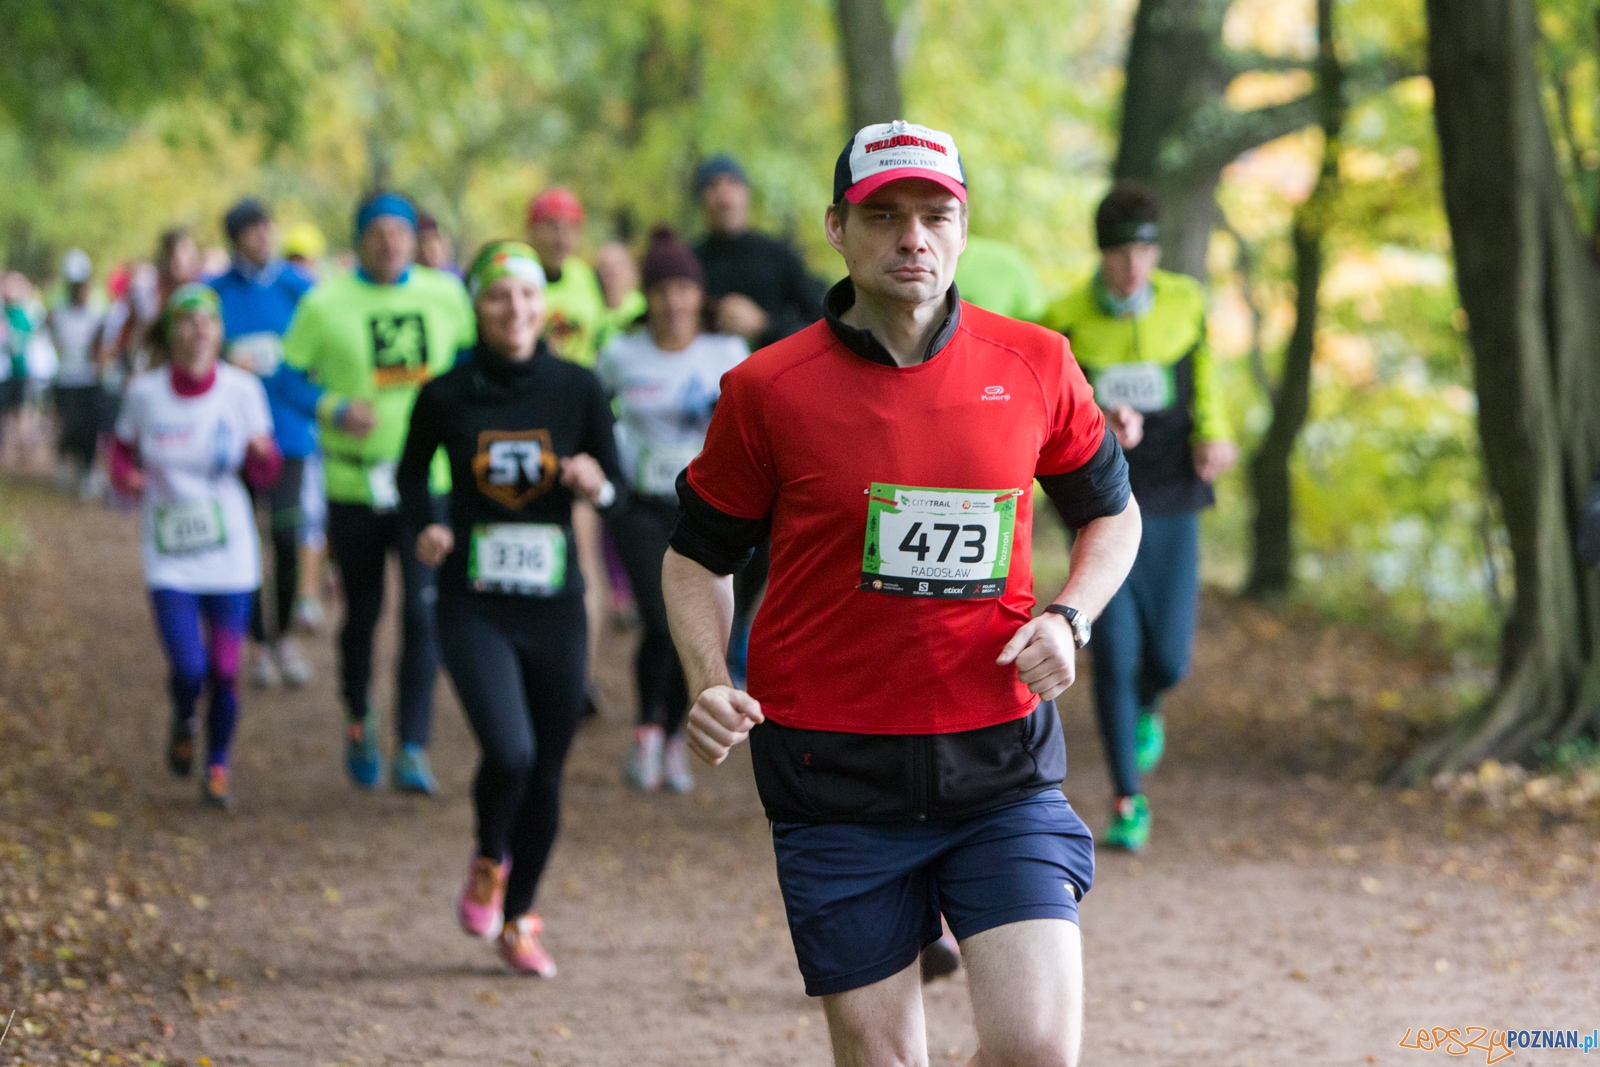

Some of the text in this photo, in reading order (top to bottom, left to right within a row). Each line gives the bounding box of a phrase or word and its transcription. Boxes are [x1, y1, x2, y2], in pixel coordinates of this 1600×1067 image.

[864, 135, 948, 156] YELLOWSTONE
[879, 159, 918, 167] NATIONAL
[898, 522, 987, 564] 473
[998, 531, 1010, 567] Poznań
[911, 566, 972, 578] RADOSŁAW
